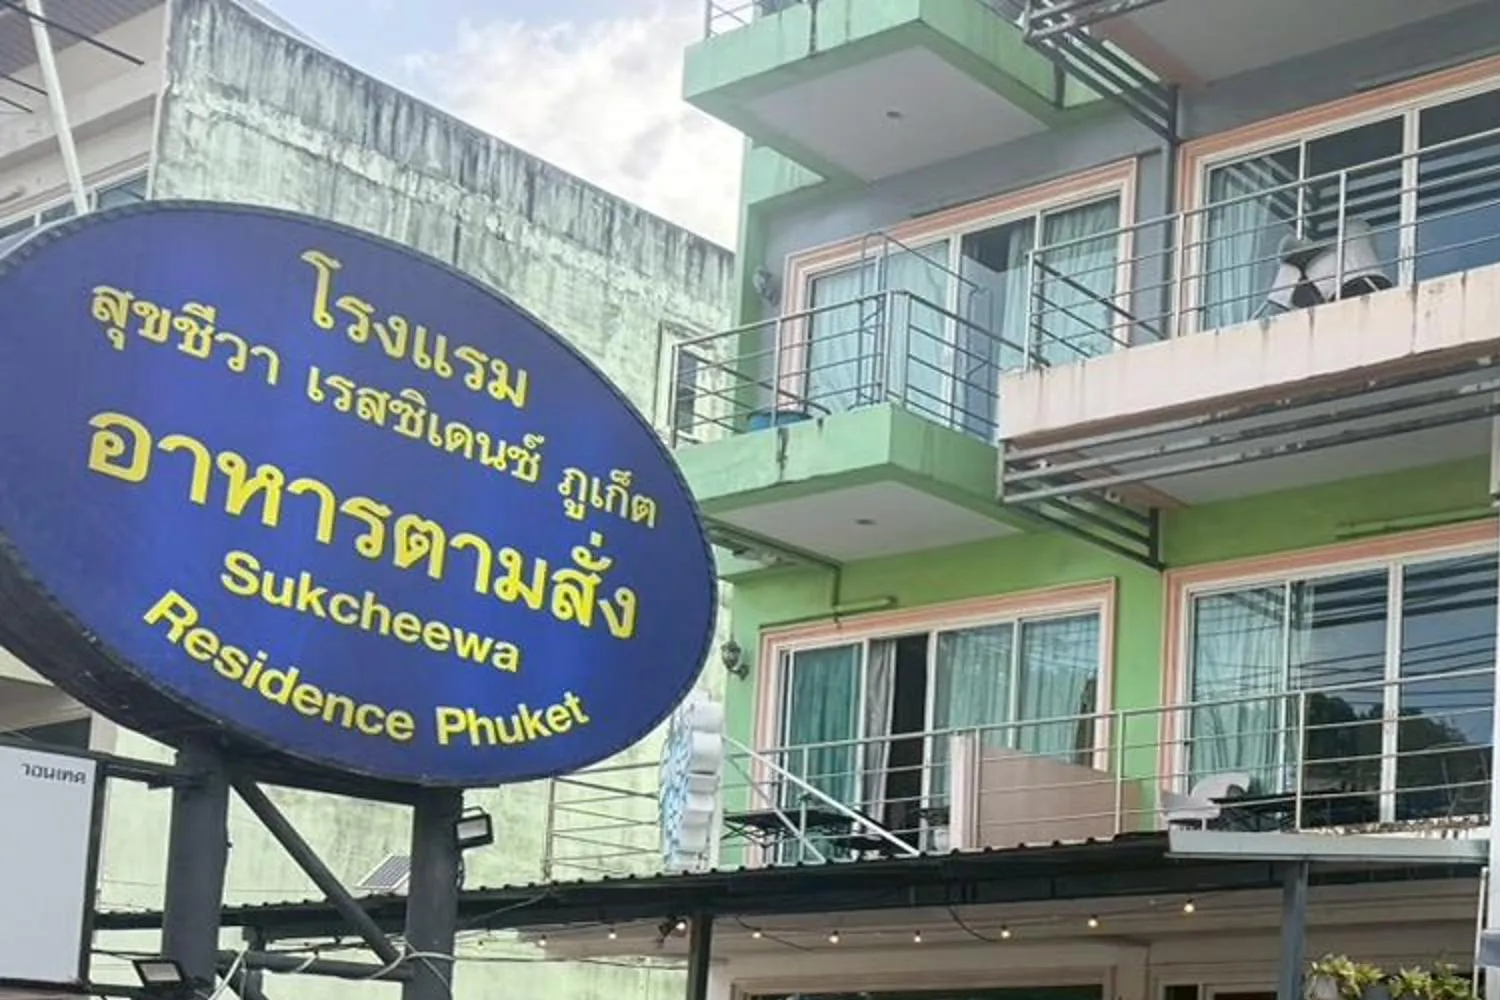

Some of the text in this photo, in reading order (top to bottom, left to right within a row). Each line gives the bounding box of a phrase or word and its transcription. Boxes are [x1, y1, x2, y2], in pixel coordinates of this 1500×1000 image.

[91, 285, 658, 530] สุขชีวา เรสซิเดนซ์ ภูเก็ต
[304, 249, 529, 410] โรงแรม
[86, 411, 638, 640] อาหารตามสั่ง
[143, 590, 592, 747] Residence Phuket
[222, 550, 522, 675] Sukcheewa
